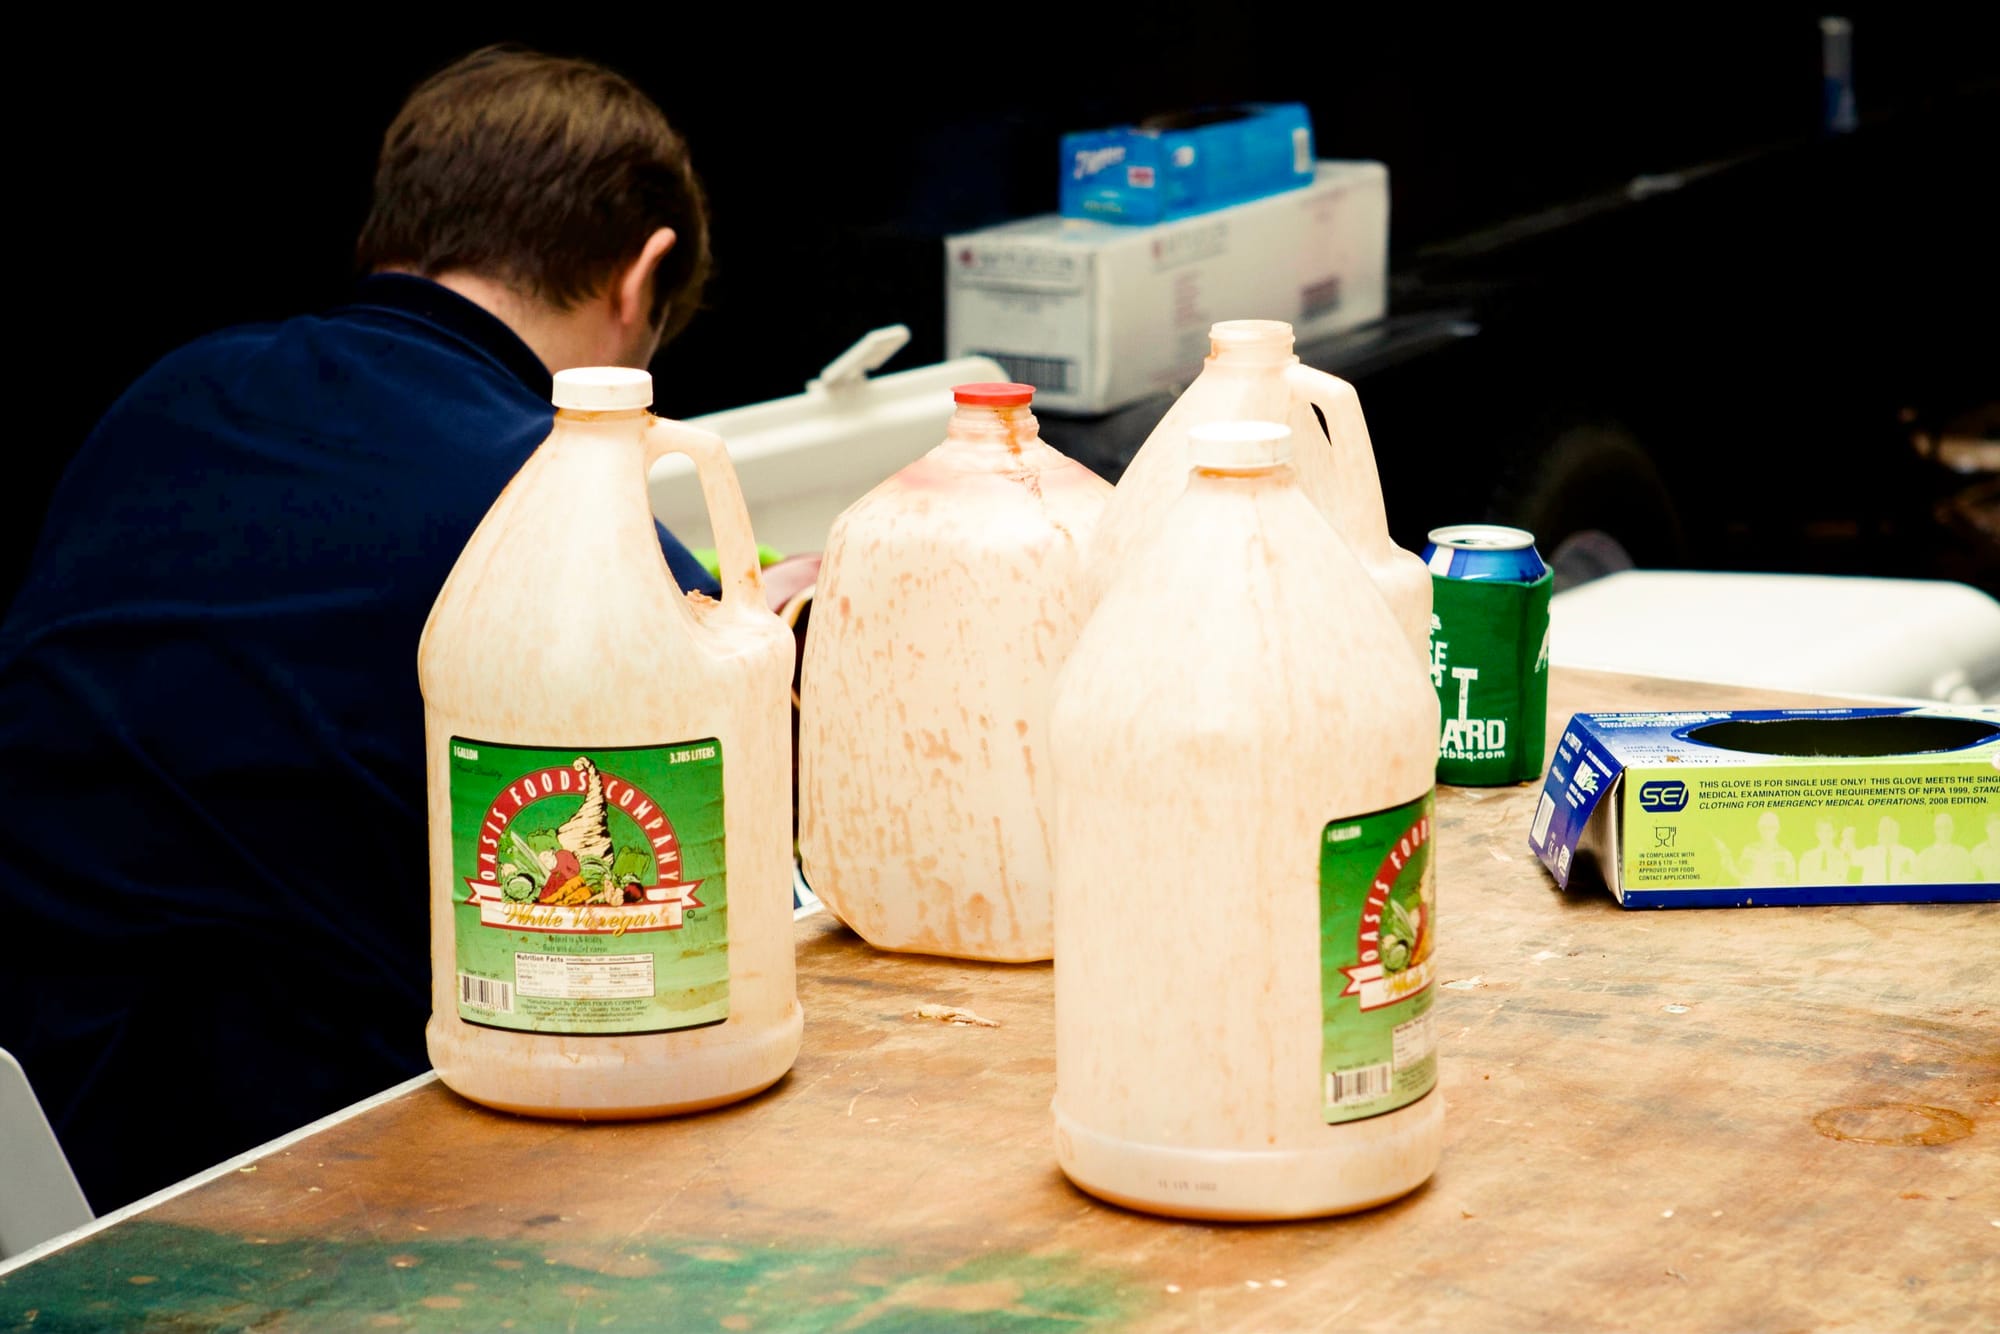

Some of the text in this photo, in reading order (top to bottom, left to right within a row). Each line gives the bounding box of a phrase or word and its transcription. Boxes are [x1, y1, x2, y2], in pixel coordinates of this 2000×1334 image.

[1439, 747, 1506, 762] tbbq.com
[1721, 780, 1751, 788] GLOVE
[1764, 779, 1783, 787] FOR
[1785, 778, 1818, 787] SINGLE
[1820, 778, 1836, 786] USE
[1840, 778, 1867, 786] ONLY!
[1870, 777, 1891, 785] THIS
[1893, 777, 1923, 785] GLOVE
[1925, 776, 1956, 784] MEETS
[1957, 776, 1975, 784] THE
[1976, 775, 2000, 784] SING
[1699, 791, 1738, 799] MEDICAL
[1741, 789, 1801, 798] EXAMINATION
[1803, 788, 1833, 797] GLOVE
[1836, 787, 1906, 797] REQUIREMENTS
[1908, 787, 1920, 795] OF
[1922, 786, 1946, 795] NFPA
[1699, 796, 1989, 810] CLOTHING FOR EMERGENCY MEDICAL OPERATIONS, 2008 EDITION.
[480, 770, 680, 882] OASIS FOODS COMPANY
[1361, 818, 1430, 963] OASIS FOOD
[501, 901, 659, 937] White Vinegar
[546, 955, 564, 963] Facts
